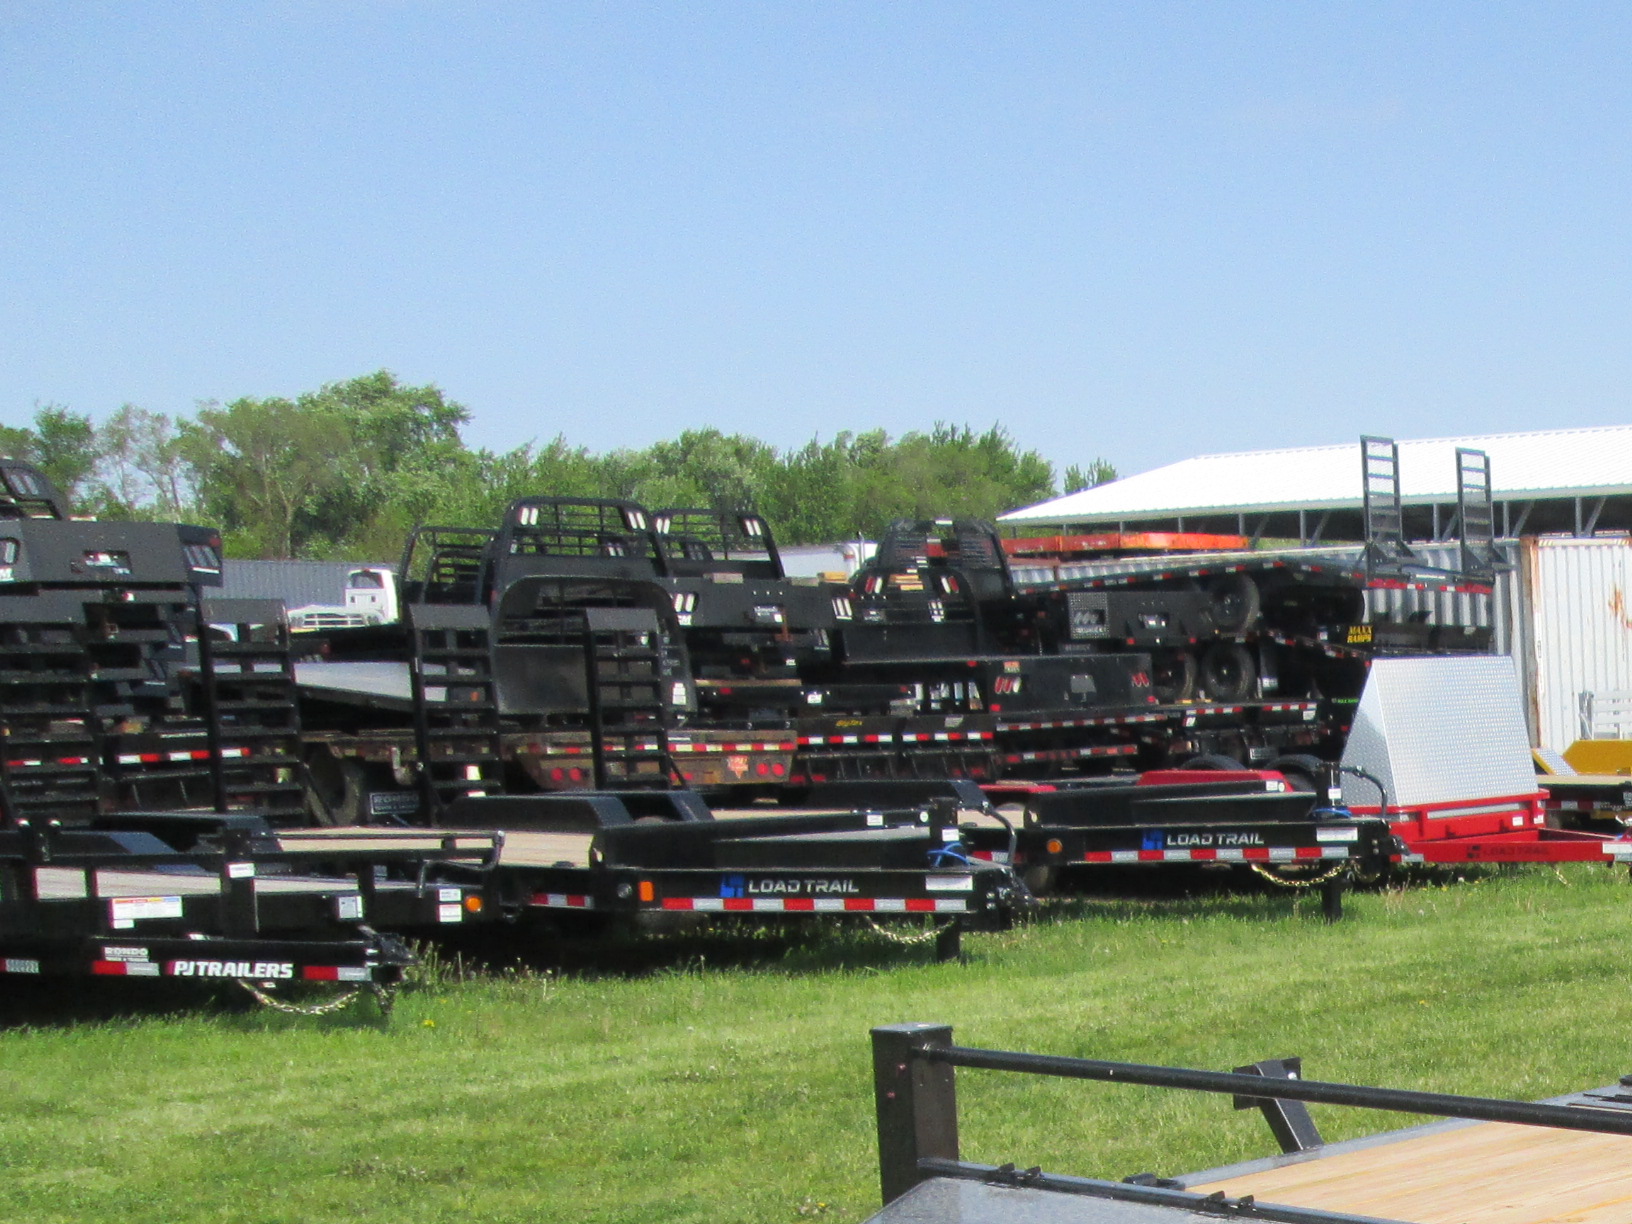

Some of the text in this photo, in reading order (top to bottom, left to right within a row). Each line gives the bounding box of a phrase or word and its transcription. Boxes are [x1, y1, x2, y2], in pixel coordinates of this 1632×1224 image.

[1167, 833, 1264, 845] LOAD TRAIL
[748, 880, 859, 893] LOAD TRAIL
[174, 961, 294, 979] PJ TRAILERS
